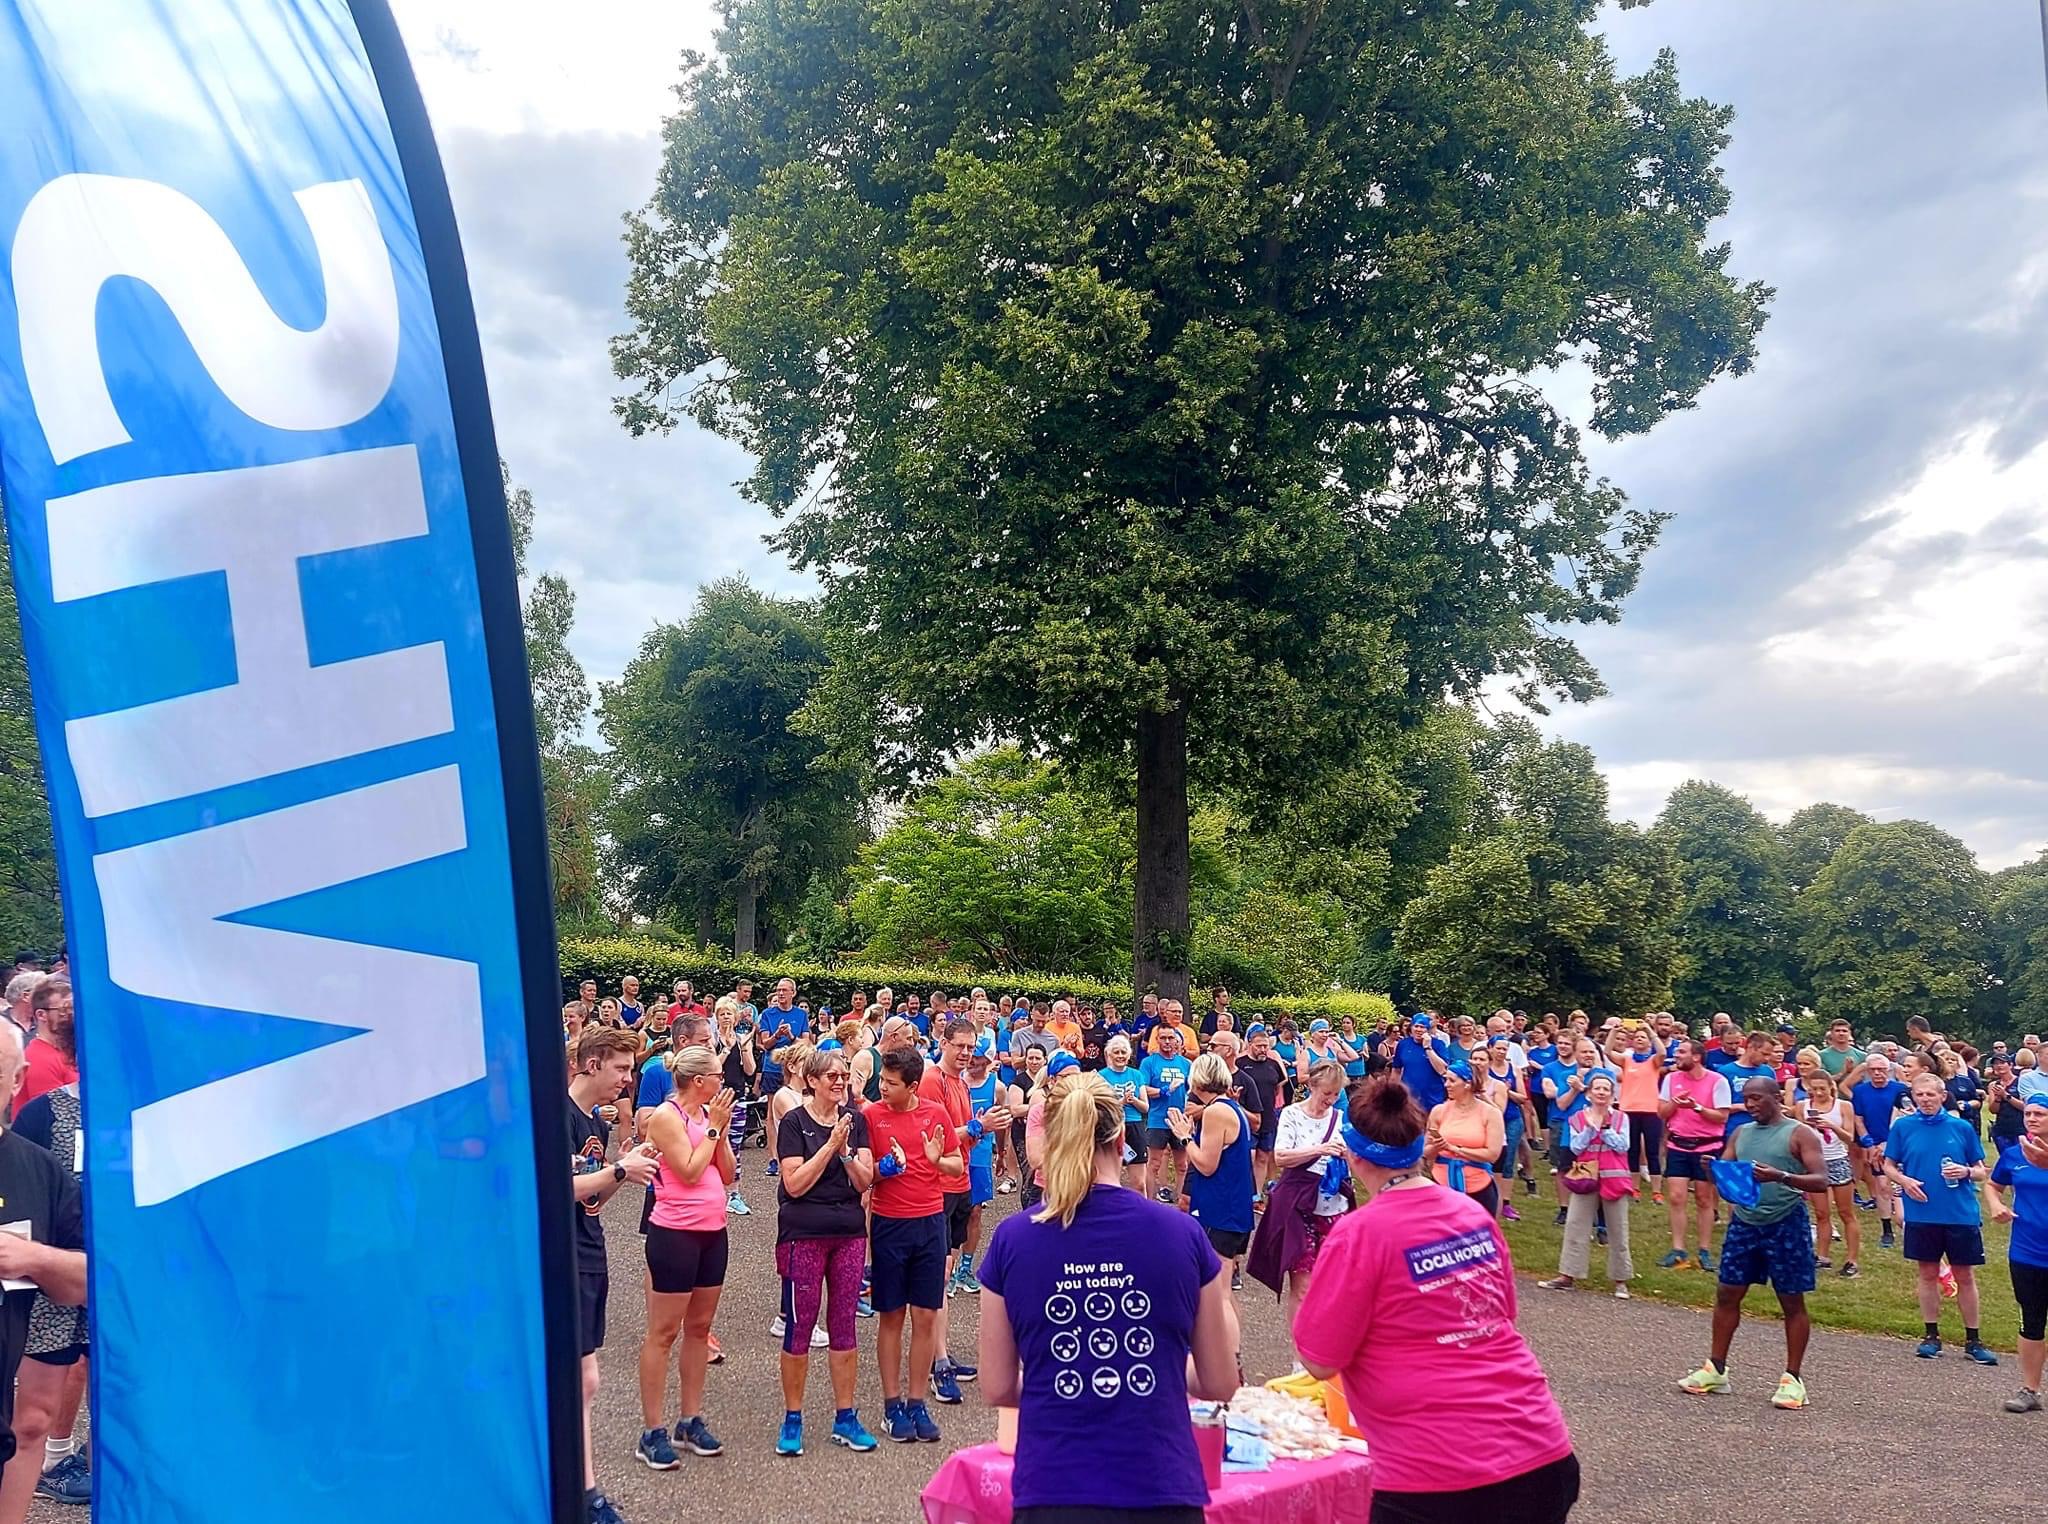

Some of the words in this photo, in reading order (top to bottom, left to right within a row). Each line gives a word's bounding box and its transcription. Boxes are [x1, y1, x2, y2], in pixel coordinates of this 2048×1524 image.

[1063, 1263, 1095, 1275] How
[1100, 1262, 1123, 1273] are
[1413, 1252, 1457, 1275] LOCAL
[1055, 1279, 1082, 1293] you
[1085, 1274, 1135, 1289] today?
